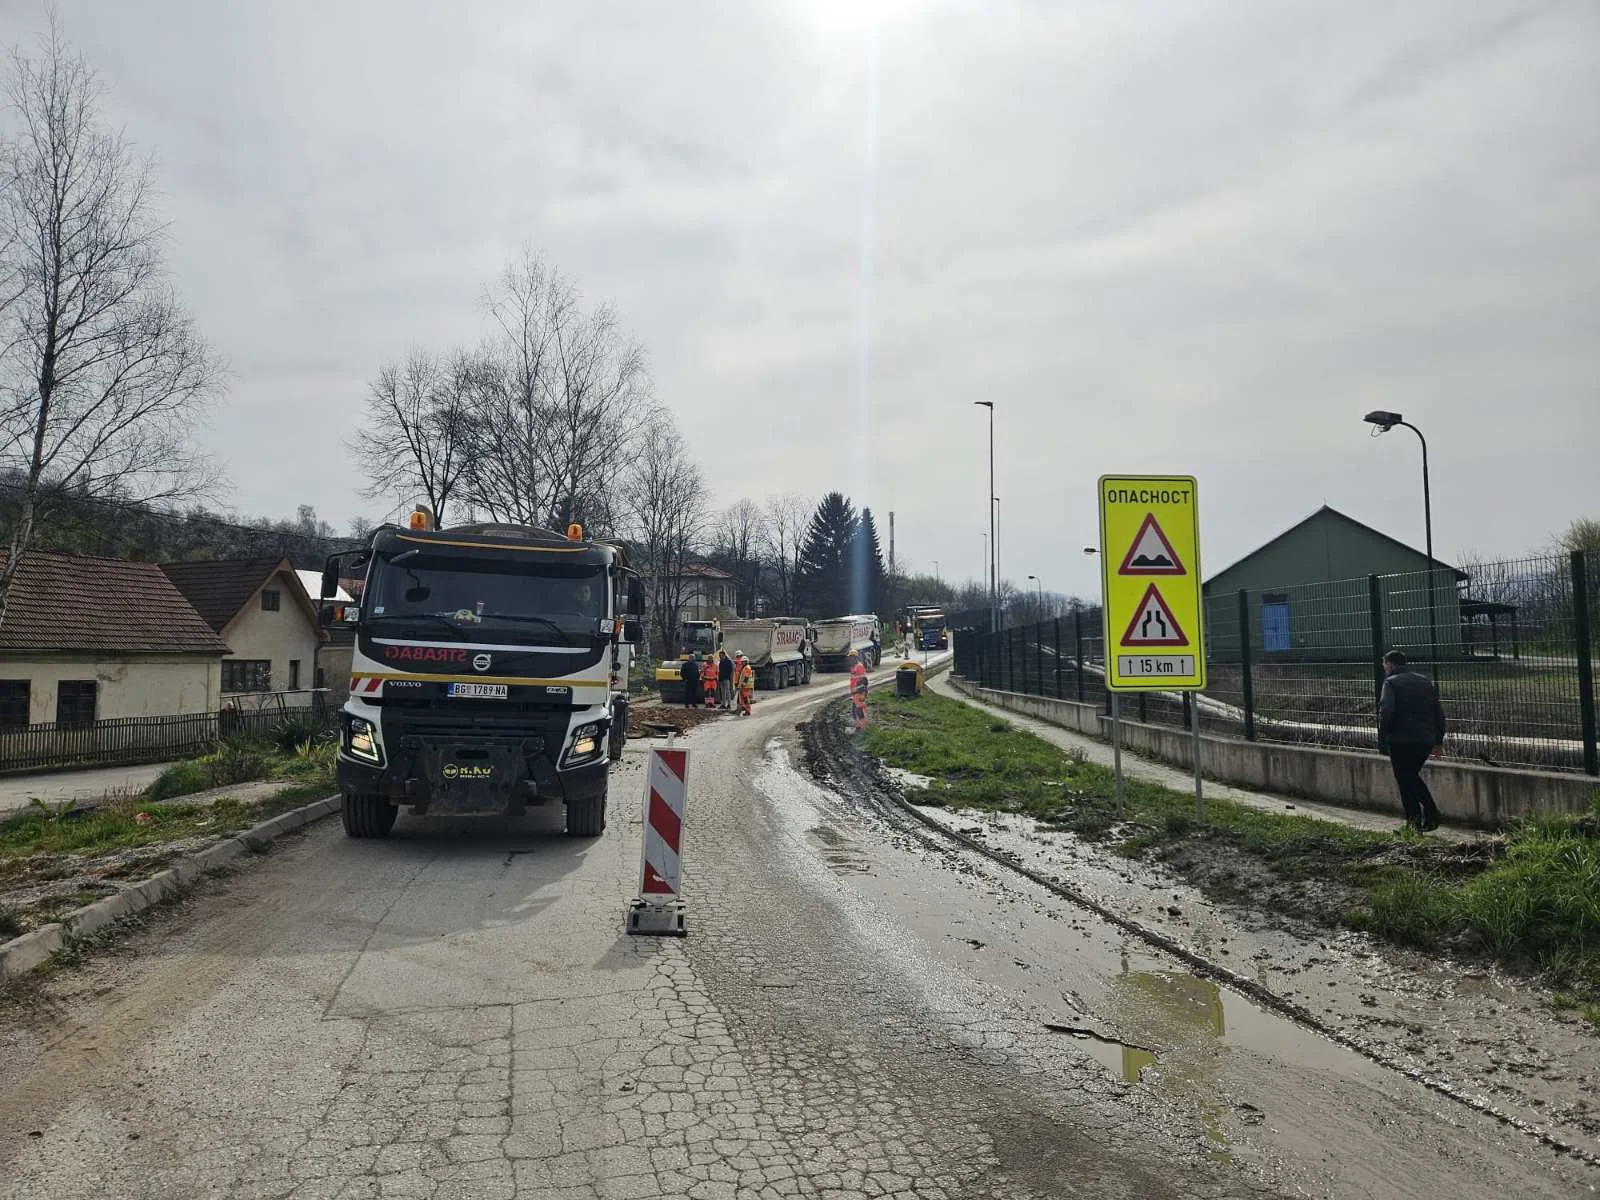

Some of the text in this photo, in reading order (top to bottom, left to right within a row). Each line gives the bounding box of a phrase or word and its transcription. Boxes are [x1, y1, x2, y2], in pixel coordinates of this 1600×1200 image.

[1107, 489, 1190, 504] ОПАСНОСТ
[1140, 659, 1173, 673] 15 km
[455, 684, 466, 694] BG
